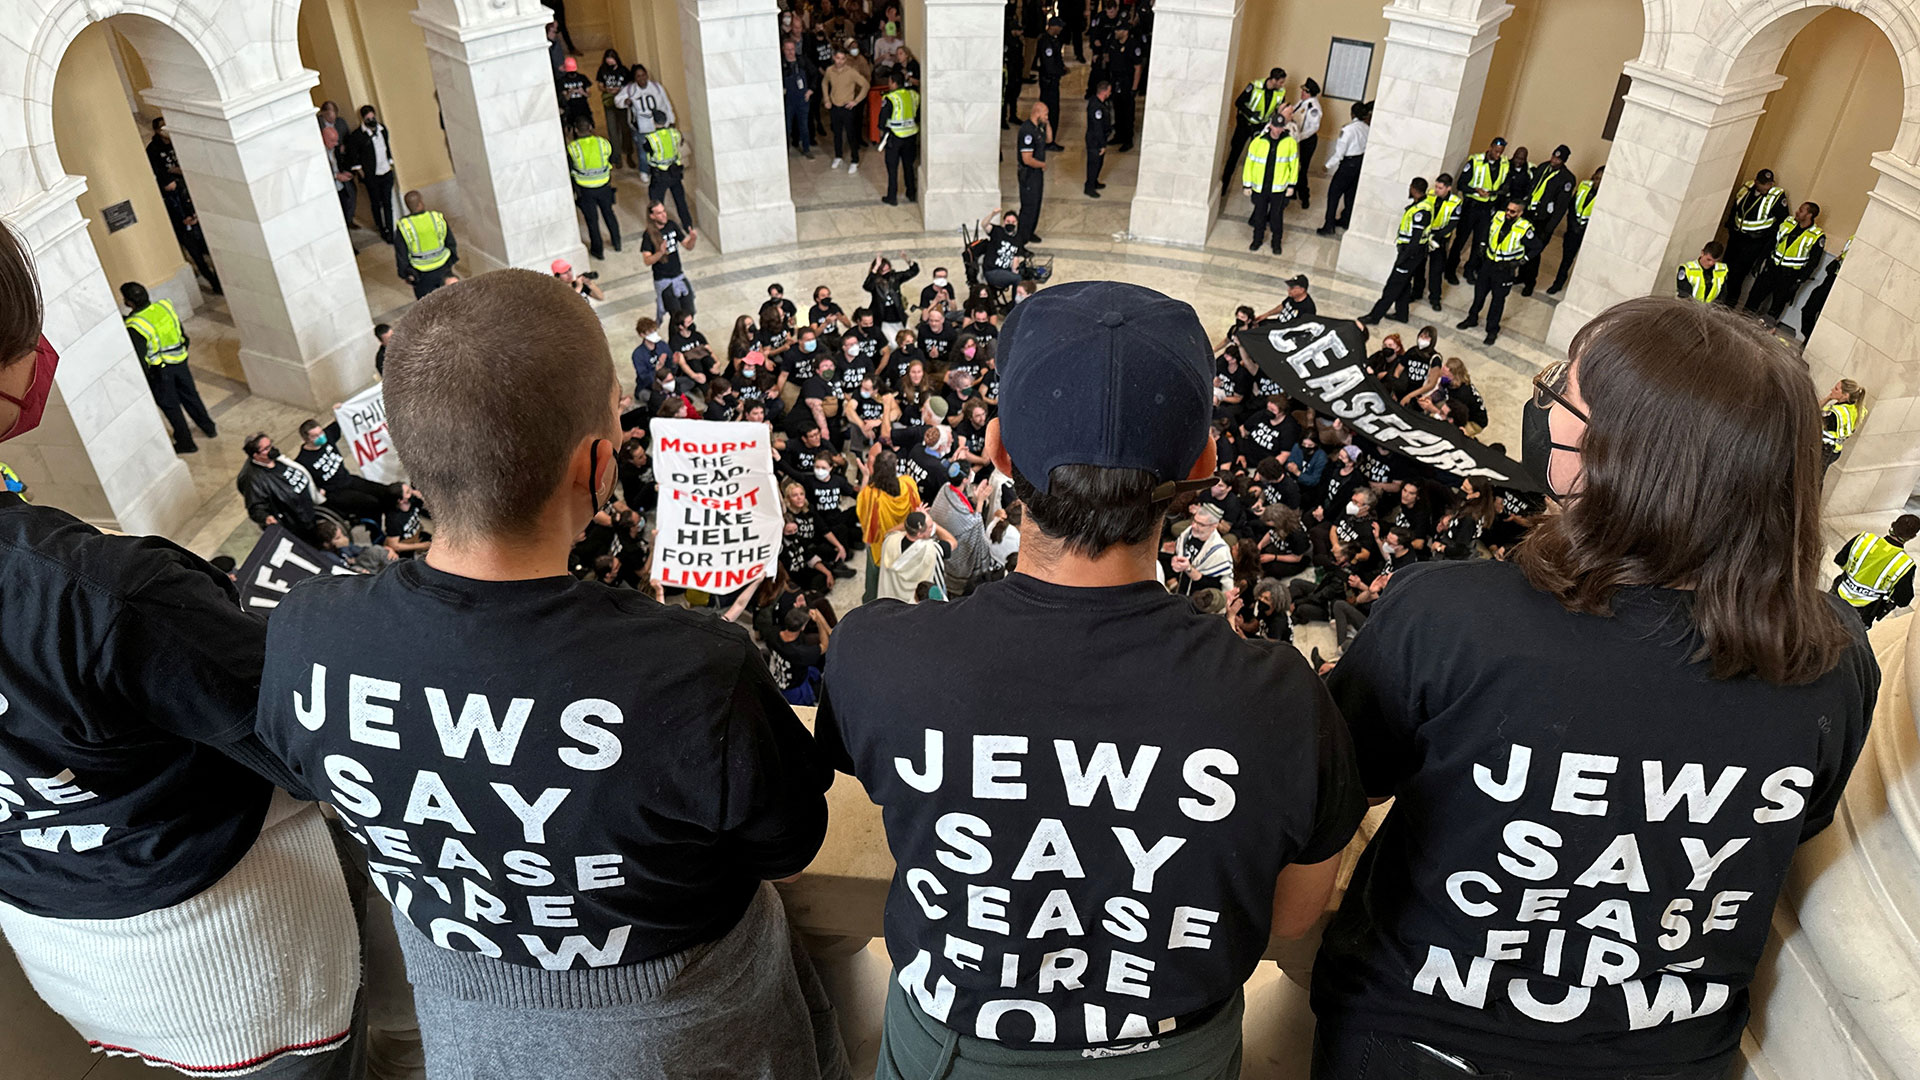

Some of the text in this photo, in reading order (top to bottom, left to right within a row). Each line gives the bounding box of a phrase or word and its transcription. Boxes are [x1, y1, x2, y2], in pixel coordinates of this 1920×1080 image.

[638, 94, 657, 112] 10
[1408, 366, 1426, 375] OUR
[354, 422, 390, 467] NE
[660, 437, 758, 456] MOURN
[688, 454, 735, 469] THE
[690, 482, 741, 498] AND
[818, 495, 839, 503] OUR
[677, 526, 760, 546] HELL
[684, 507, 754, 527] LIKE
[662, 547, 714, 567] FOR
[721, 543, 772, 566] THE
[662, 563, 766, 589] LIVING
[1845, 577, 1877, 598] POLICE
[292, 662, 625, 772] JEWS
[893, 727, 1240, 823] JEWS
[1472, 743, 1815, 825] JEWS
[323, 753, 572, 845] SAY
[934, 811, 1188, 894] SAY
[1496, 819, 1752, 893] SAY
[905, 867, 1221, 951] CEASE
[1445, 870, 1754, 952] CEASE
[943, 932, 1157, 999] FIRE
[1411, 944, 1731, 1031] NOW
[897, 948, 1177, 1044] NOW
